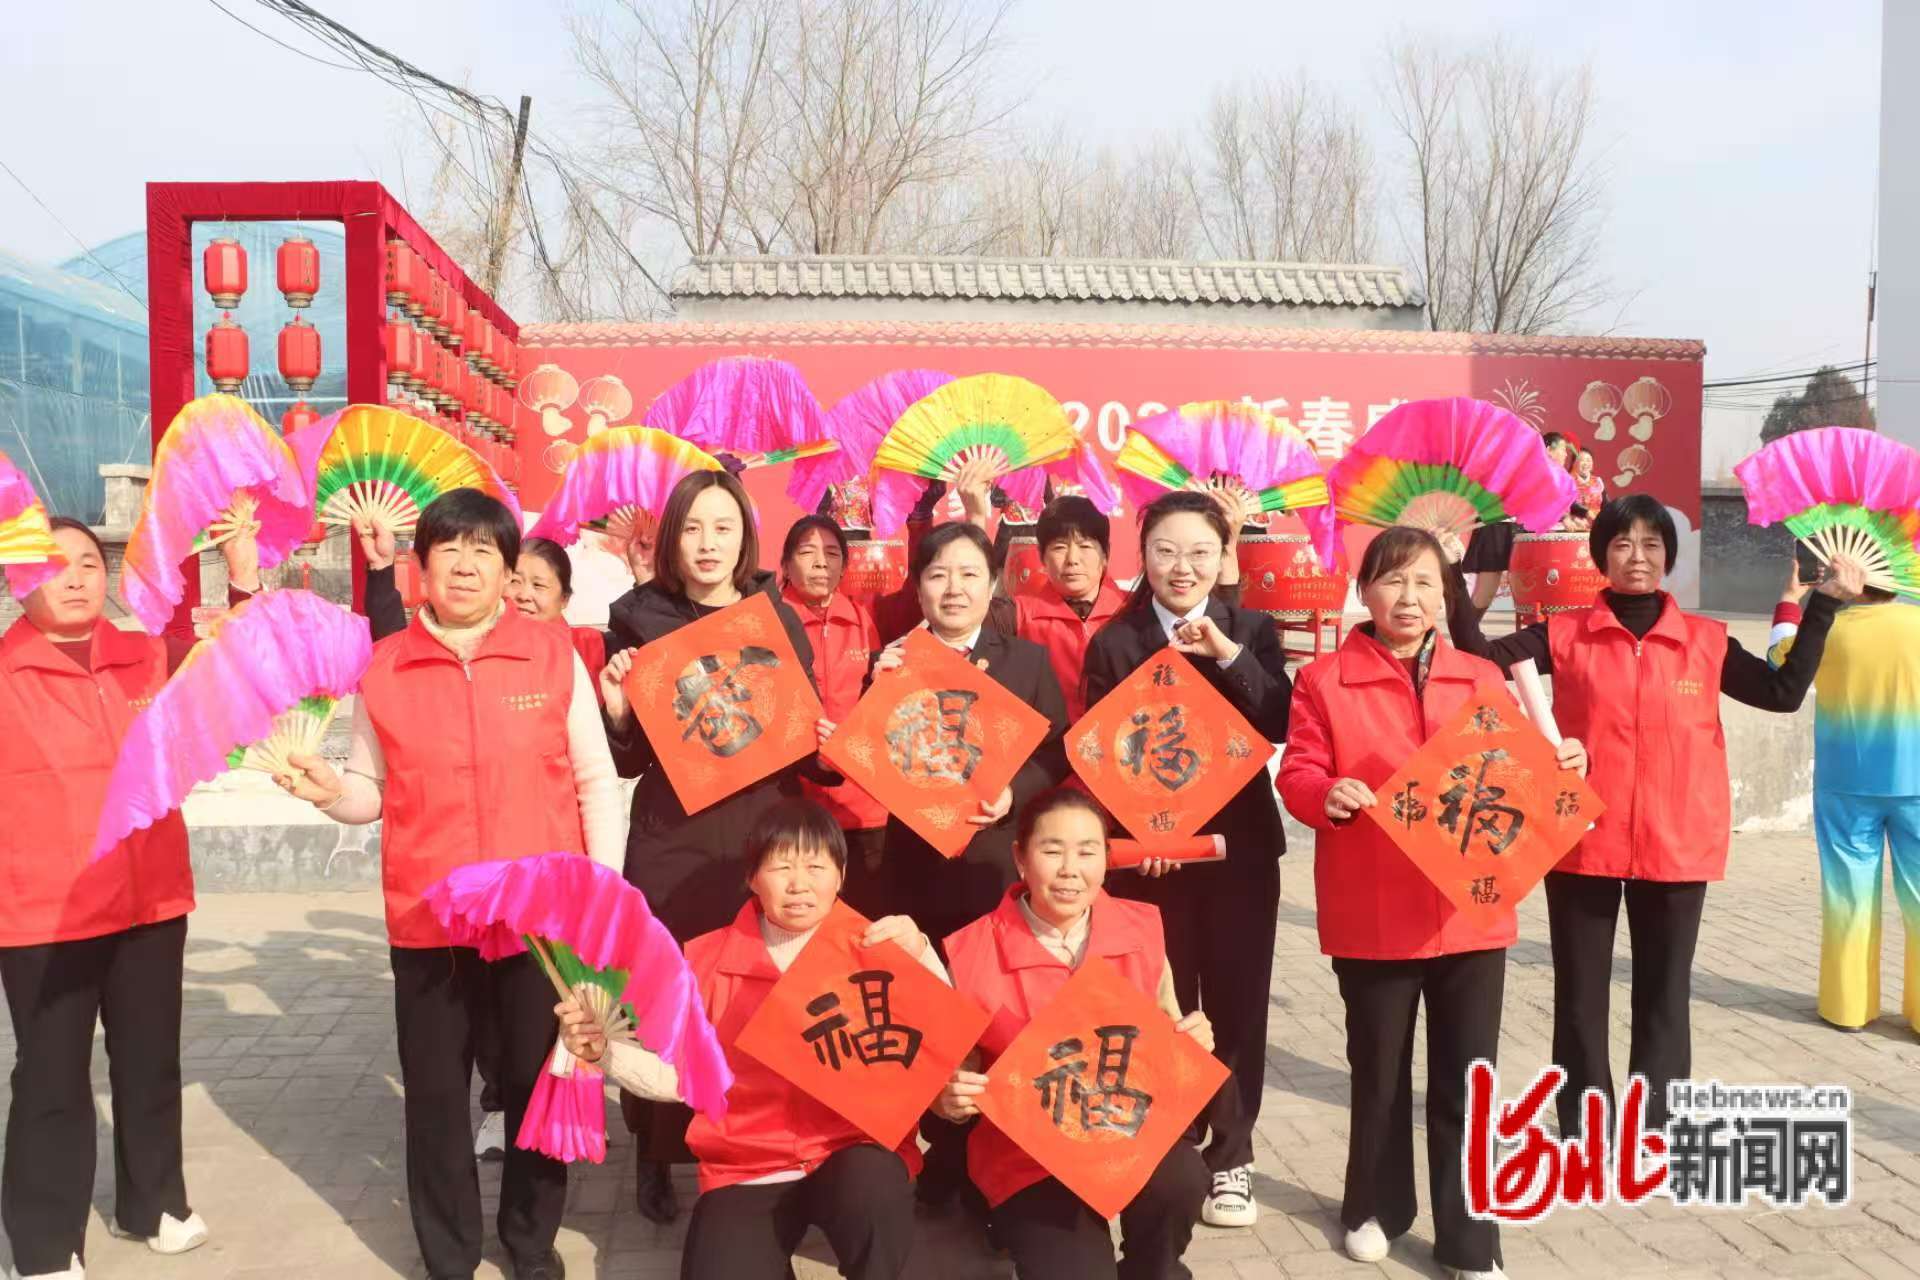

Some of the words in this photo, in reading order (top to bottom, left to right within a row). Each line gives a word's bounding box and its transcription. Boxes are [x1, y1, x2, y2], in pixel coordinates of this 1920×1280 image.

[884, 689, 983, 784] 福
[1120, 705, 1200, 791] 福
[1436, 748, 1525, 857] 福
[801, 970, 924, 1071] 福
[1034, 1024, 1153, 1138] 福
